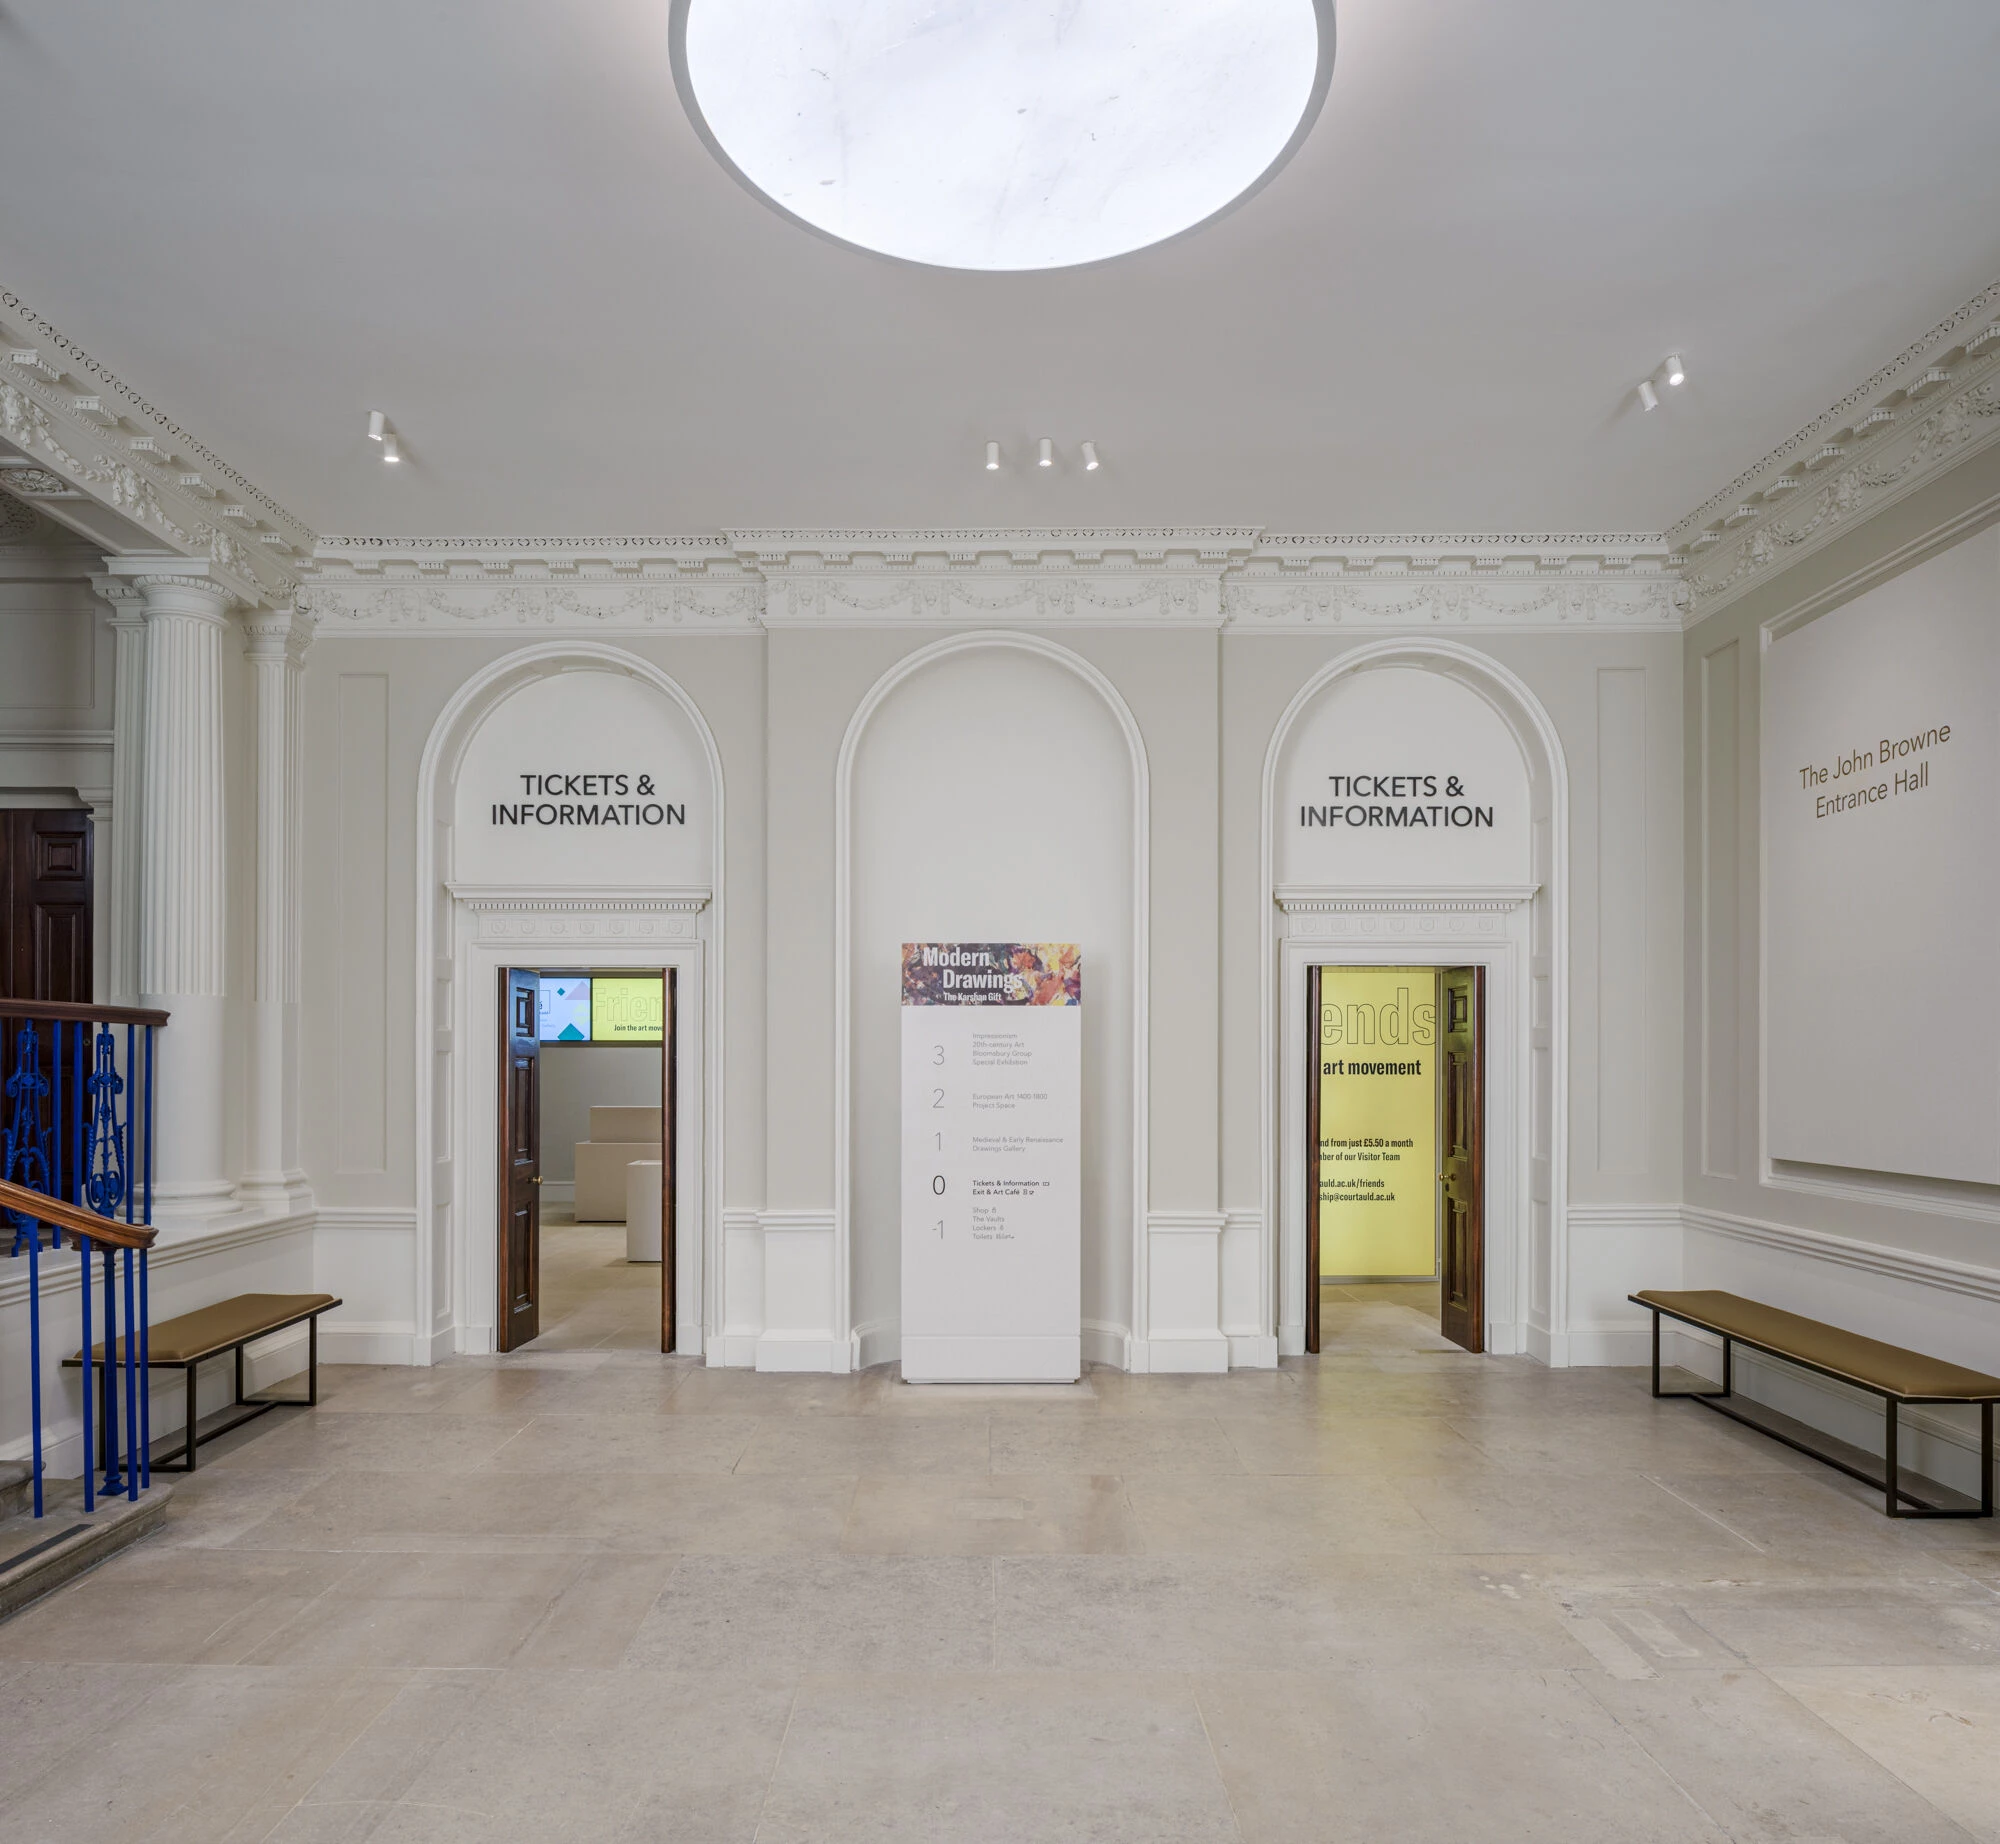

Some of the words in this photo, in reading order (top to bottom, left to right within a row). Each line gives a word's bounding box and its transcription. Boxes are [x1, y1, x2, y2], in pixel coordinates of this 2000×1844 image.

[1799, 764, 1829, 789] The
[1832, 749, 1873, 779] John
[1879, 725, 1951, 764] Browne
[520, 774, 629, 796] TICKETS
[636, 774, 655, 796] &
[1328, 775, 1437, 797] TICKETS
[1445, 775, 1464, 797] &
[1816, 783, 1888, 818] Entrance
[1894, 761, 1928, 795] Hall
[492, 804, 685, 825] INFORMATION
[1300, 805, 1493, 827] INFORMATION
[923, 947, 990, 967] Modern
[942, 969, 1023, 994] Drawings
[944, 993, 956, 1001] The
[988, 992, 1002, 1001] Gift
[614, 1024, 626, 1032] Join
[627, 1024, 637, 1032] the
[638, 1024, 647, 1032] art
[932, 1045, 945, 1066] 3
[1323, 1060, 1344, 1076] art
[1348, 1060, 1422, 1076] movement
[932, 1088, 945, 1109] 2
[996, 1102, 1016, 1110] Space
[935, 1131, 942, 1152] 1
[972, 1145, 1002, 1153] Drawings
[1002, 1145, 1026, 1153] Gallery
[1009, 1136, 1025, 1144] Early
[1330, 1139, 1347, 1148] from
[1348, 1139, 1362, 1149] just
[1363, 1139, 1384, 1148] £5.50
[1391, 1139, 1414, 1148] month
[1335, 1152, 1343, 1161] of
[1357, 1152, 1381, 1161] Visitor
[1382, 1152, 1401, 1161] Team
[932, 1175, 946, 1196] 0
